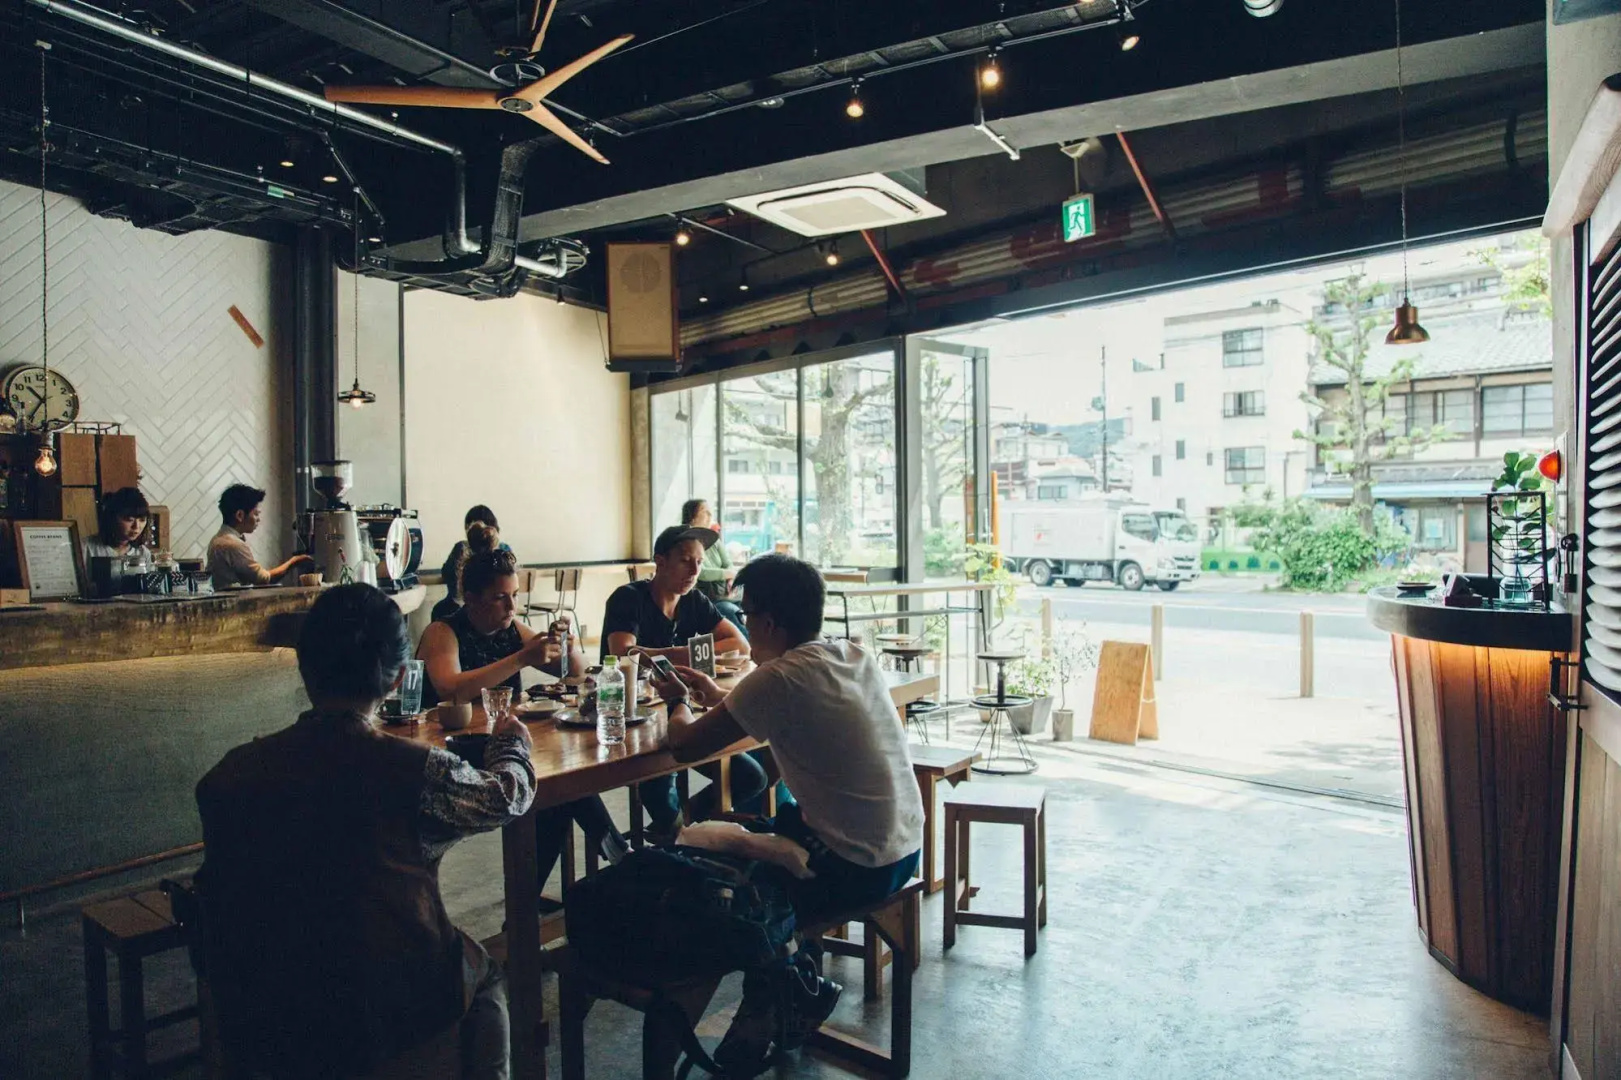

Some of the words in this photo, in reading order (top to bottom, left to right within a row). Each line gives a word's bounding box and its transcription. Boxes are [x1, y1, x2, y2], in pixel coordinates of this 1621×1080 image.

[15, 383, 24, 391] 10
[60, 387, 67, 395] 2
[12, 394, 18, 402] 9
[66, 399, 72, 407] 3
[62, 410, 69, 418] 4
[694, 643, 710, 662] 30
[407, 669, 418, 690] 17
